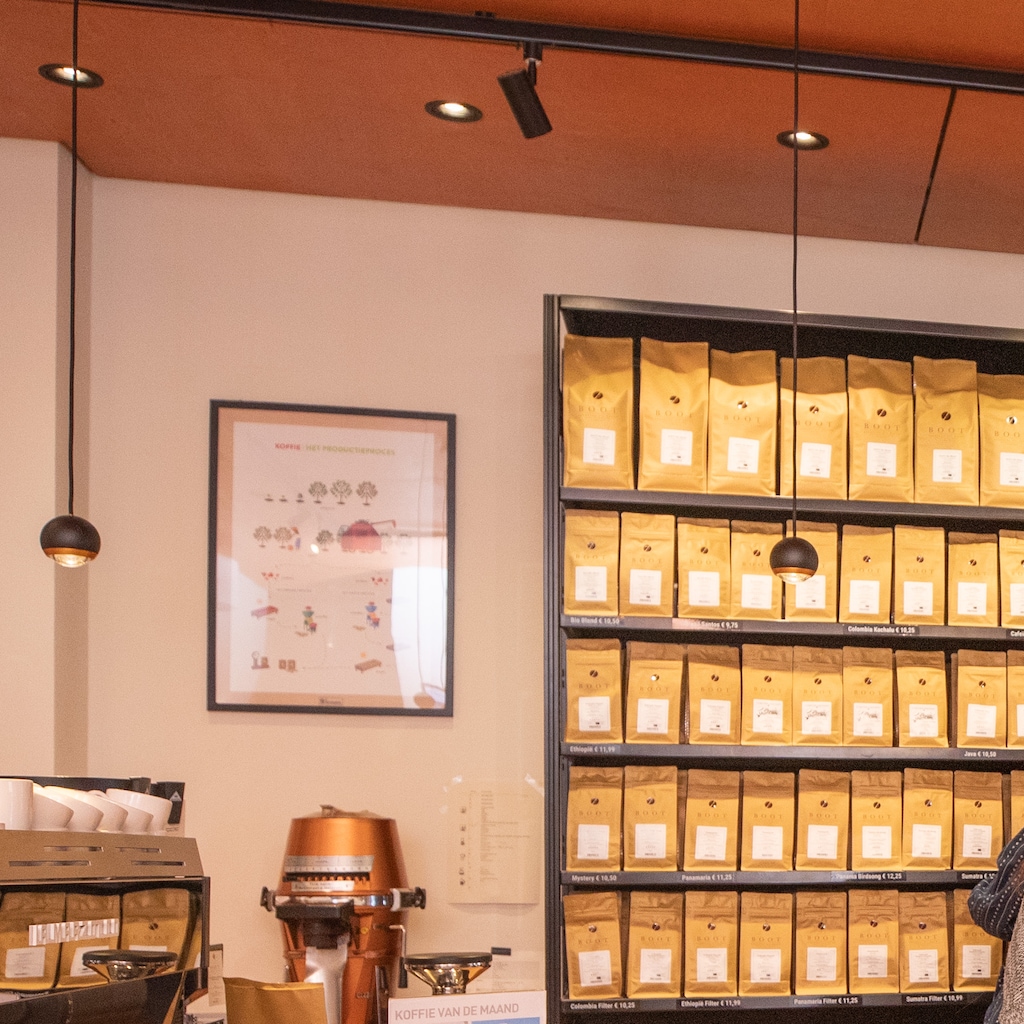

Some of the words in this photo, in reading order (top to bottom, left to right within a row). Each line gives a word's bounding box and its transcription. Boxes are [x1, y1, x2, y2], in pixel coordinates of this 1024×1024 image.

[982, 750, 997, 758] 10,50
[572, 874, 595, 883] Mystery
[600, 874, 617, 882] 10,50
[717, 874, 732, 882] 11,25
[858, 872, 881, 881] Birdsong
[887, 873, 902, 881] 12,25
[725, 999, 741, 1008] 11,99
[843, 996, 858, 1005] 11,25
[948, 995, 963, 1003] 10,99
[570, 1002, 597, 1010] Colombia
[619, 1002, 635, 1010] 10,25
[394, 1008, 436, 1020] KOFFIE
[438, 1006, 461, 1018] VAN
[463, 1006, 478, 1016] DE
[480, 1003, 519, 1015] MAAND
